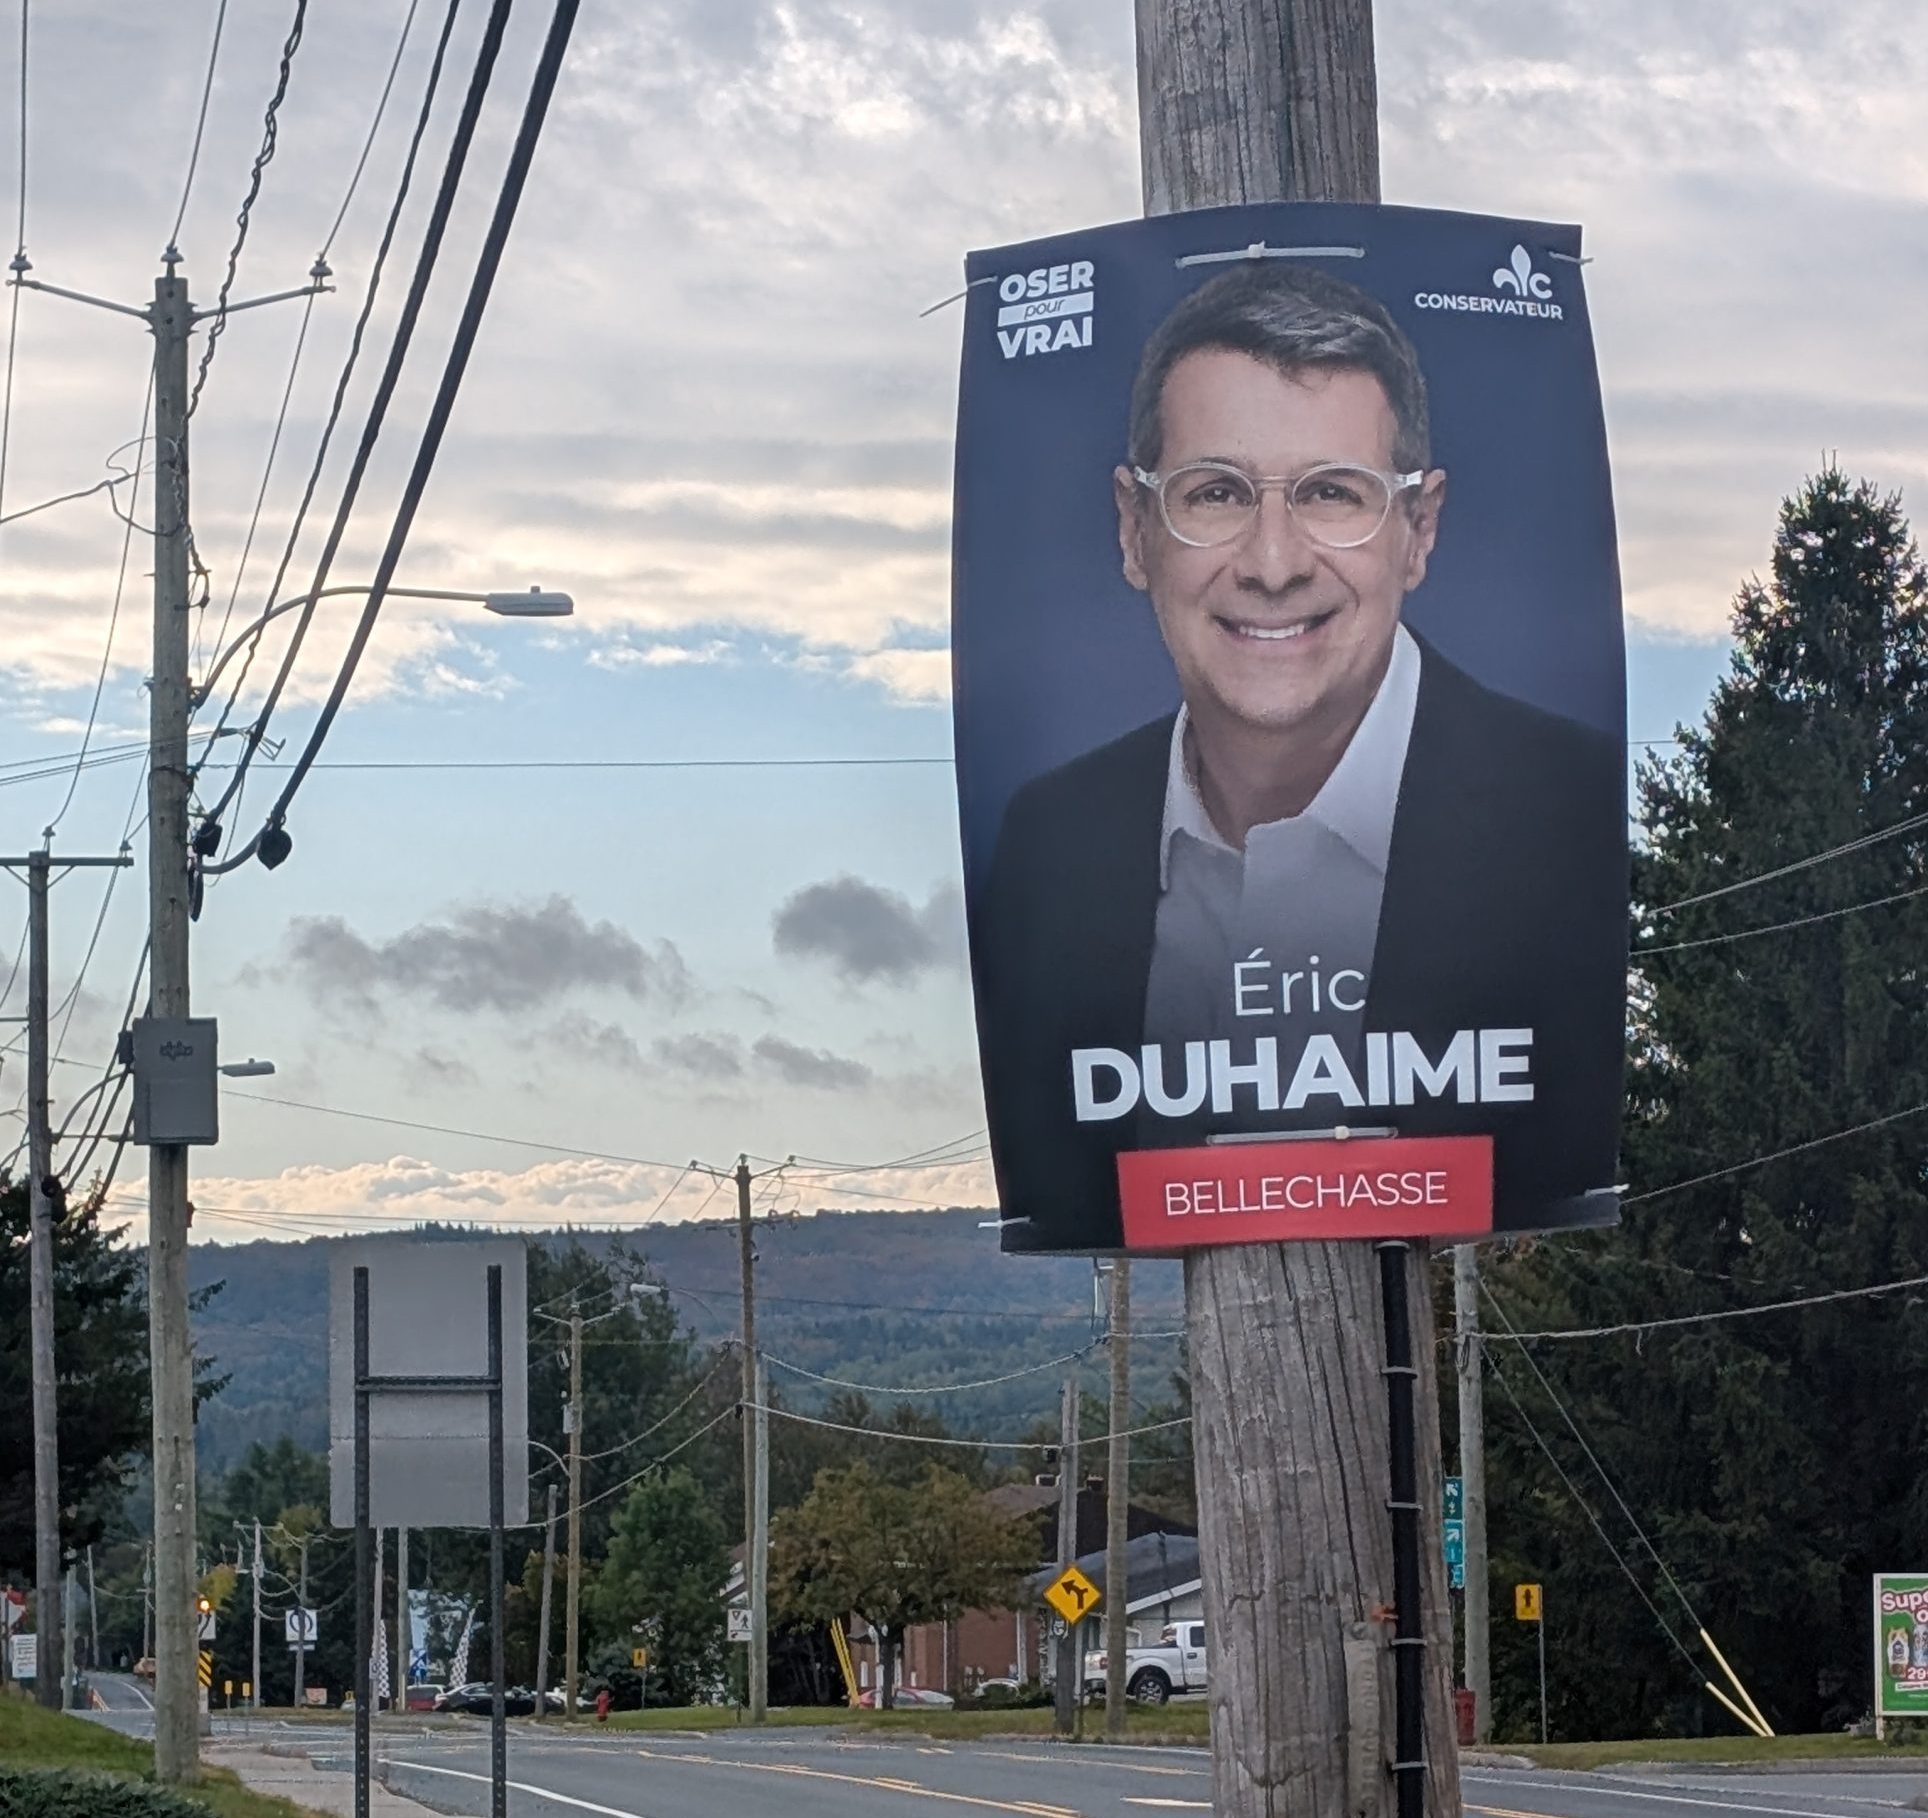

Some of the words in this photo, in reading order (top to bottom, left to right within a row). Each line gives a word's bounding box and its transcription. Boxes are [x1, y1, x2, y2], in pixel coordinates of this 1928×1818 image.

[1000, 261, 1094, 302] OSER
[1024, 300, 1065, 321] pour
[1414, 293, 1564, 320] CONSERVATEUR
[997, 316, 1092, 359] VRAI
[1234, 948, 1366, 1016] Éric
[1071, 1028, 1535, 1122] DUHAIME
[1164, 1171, 1448, 1216] BELLECHASSE
